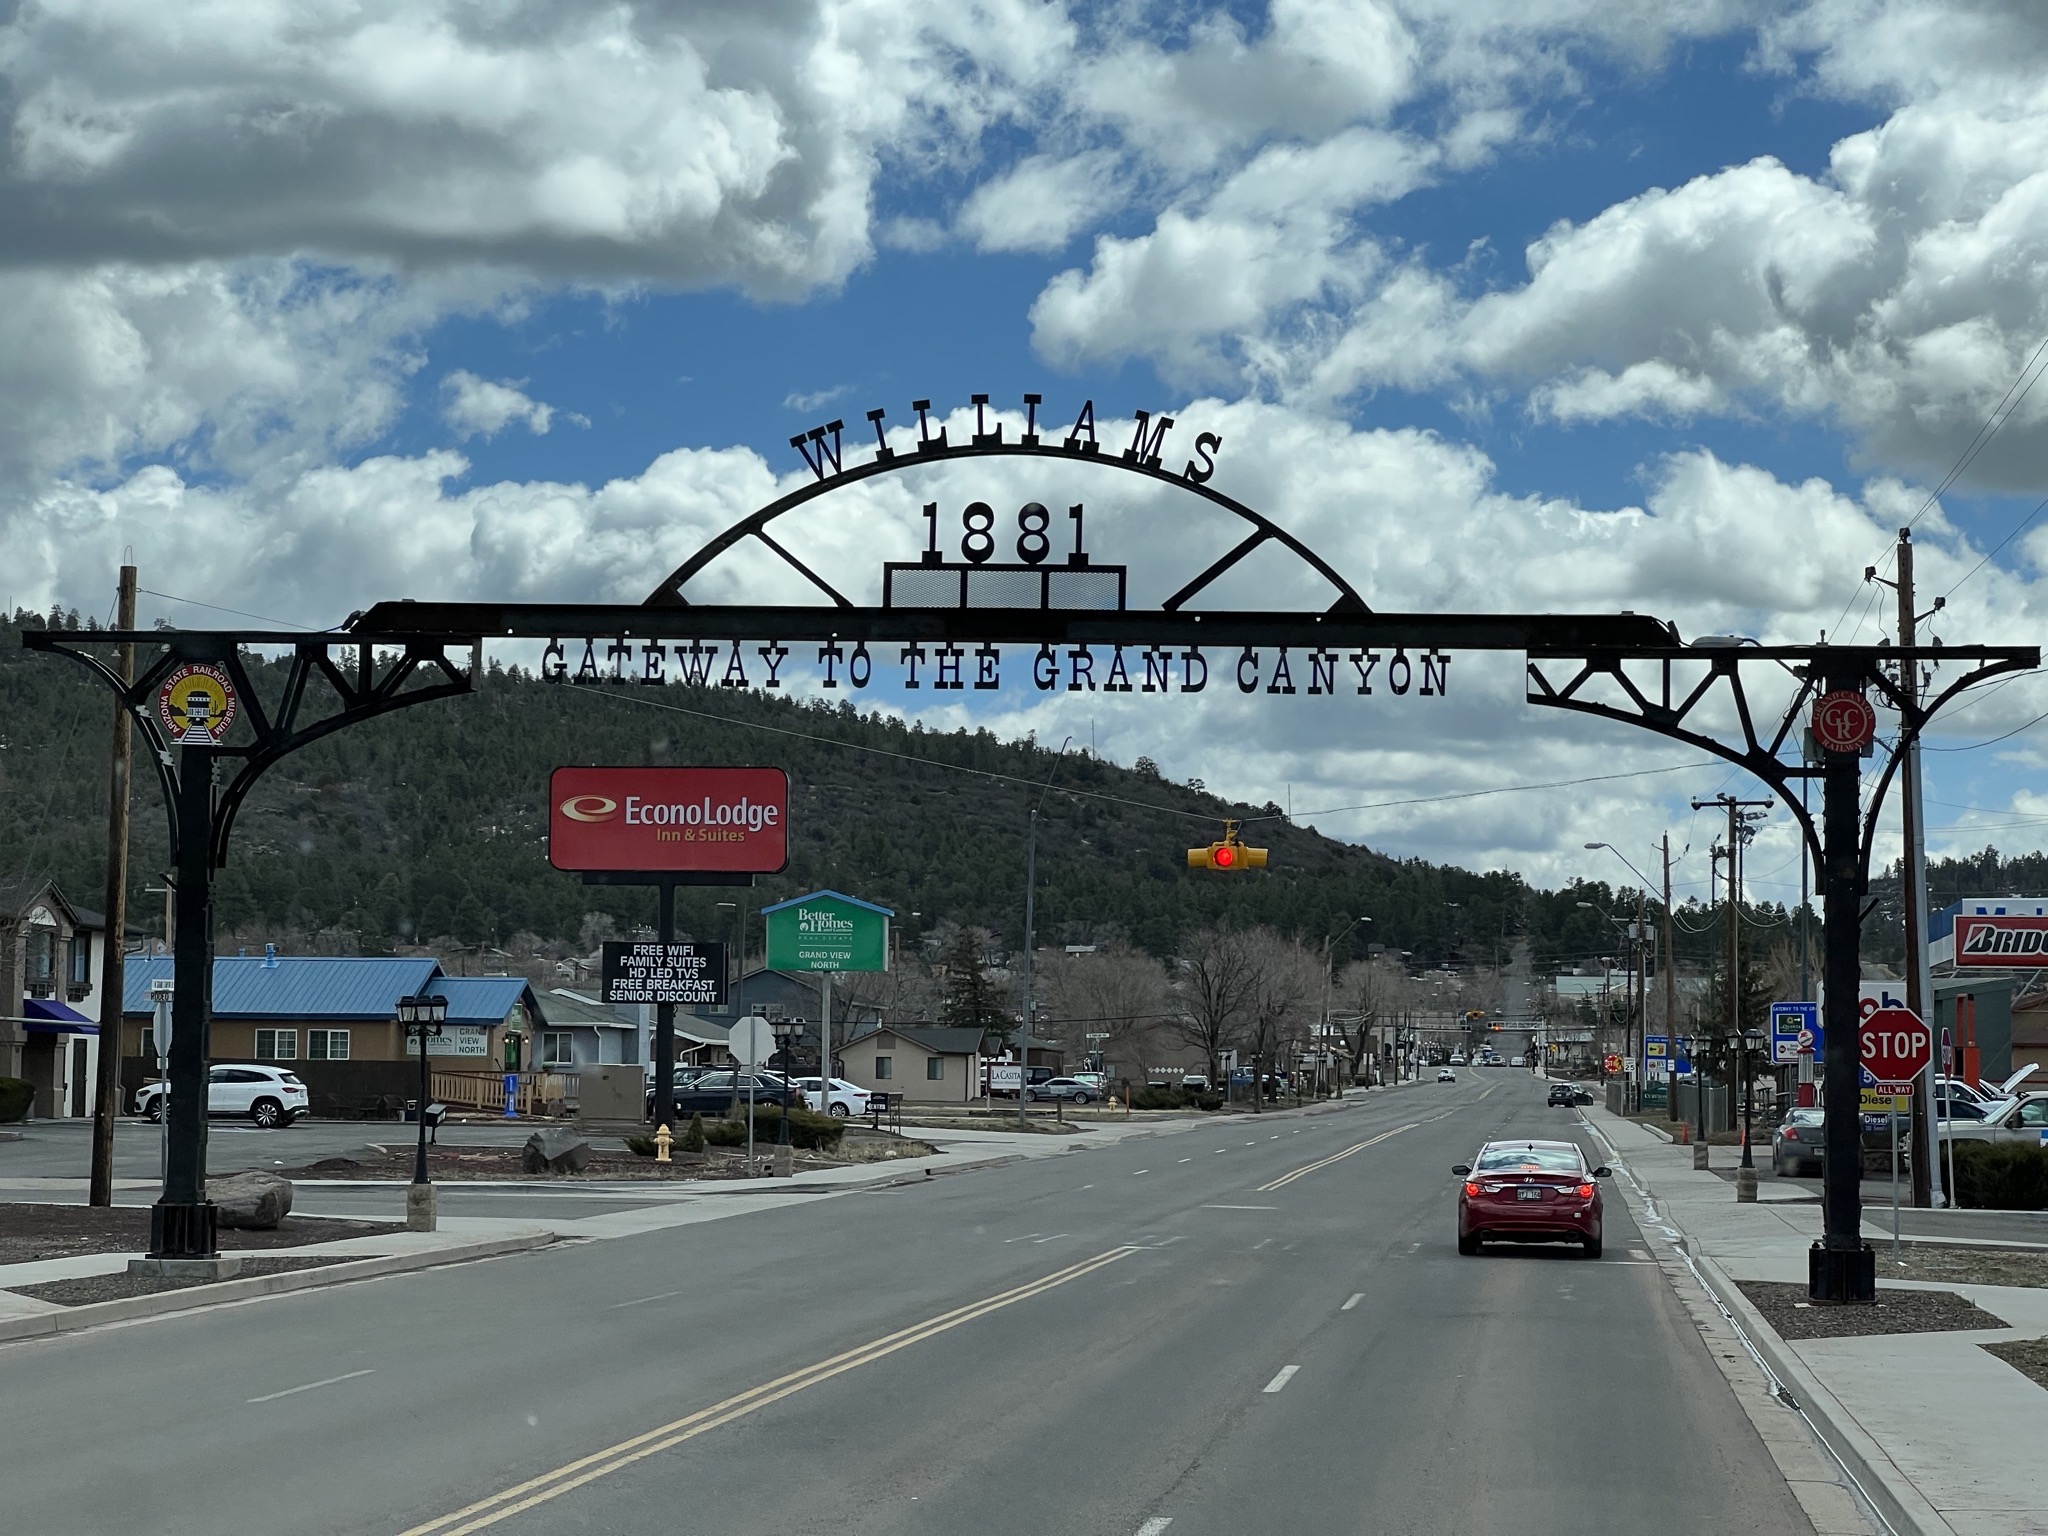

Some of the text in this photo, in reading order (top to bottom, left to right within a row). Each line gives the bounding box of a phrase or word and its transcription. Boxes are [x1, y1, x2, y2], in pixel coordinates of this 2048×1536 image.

[789, 394, 1223, 485] WILLIAMS
[922, 502, 1089, 565] 1881
[542, 644, 1451, 696] GATEWAY TO THE GRAND CANYON
[160, 665, 236, 735] ARIZONA STATE RAILROAD MUSEUM
[1813, 692, 1874, 720] GRAND CANYON
[1821, 739, 1866, 753] RAILWAY
[625, 796, 778, 832] EconoLodge
[656, 828, 745, 842] Inn & Suites
[798, 908, 835, 921] Better
[810, 920, 853, 932] Homes
[633, 944, 694, 956] FREE WIFI
[798, 951, 851, 959] GRAND VIEW
[620, 956, 707, 968] FAMILY SUITES
[811, 961, 839, 969] NORTH
[629, 967, 699, 979] HD LED TVS
[612, 979, 715, 991] FREE BREAKFAST
[609, 990, 717, 1002] SENIOR DISCOUNT
[459, 1028, 481, 1036] GRAN
[427, 1035, 452, 1043] omes
[459, 1037, 480, 1045] VIEW
[458, 1046, 486, 1054] NORTH
[1861, 1032, 1927, 1059] STOP
[992, 1069, 1021, 1080] LA CASITA
[1878, 1086, 1911, 1094] ALL WAY
[1860, 1094, 1893, 1105] Diese
[1864, 1114, 1888, 1124] Diesel
